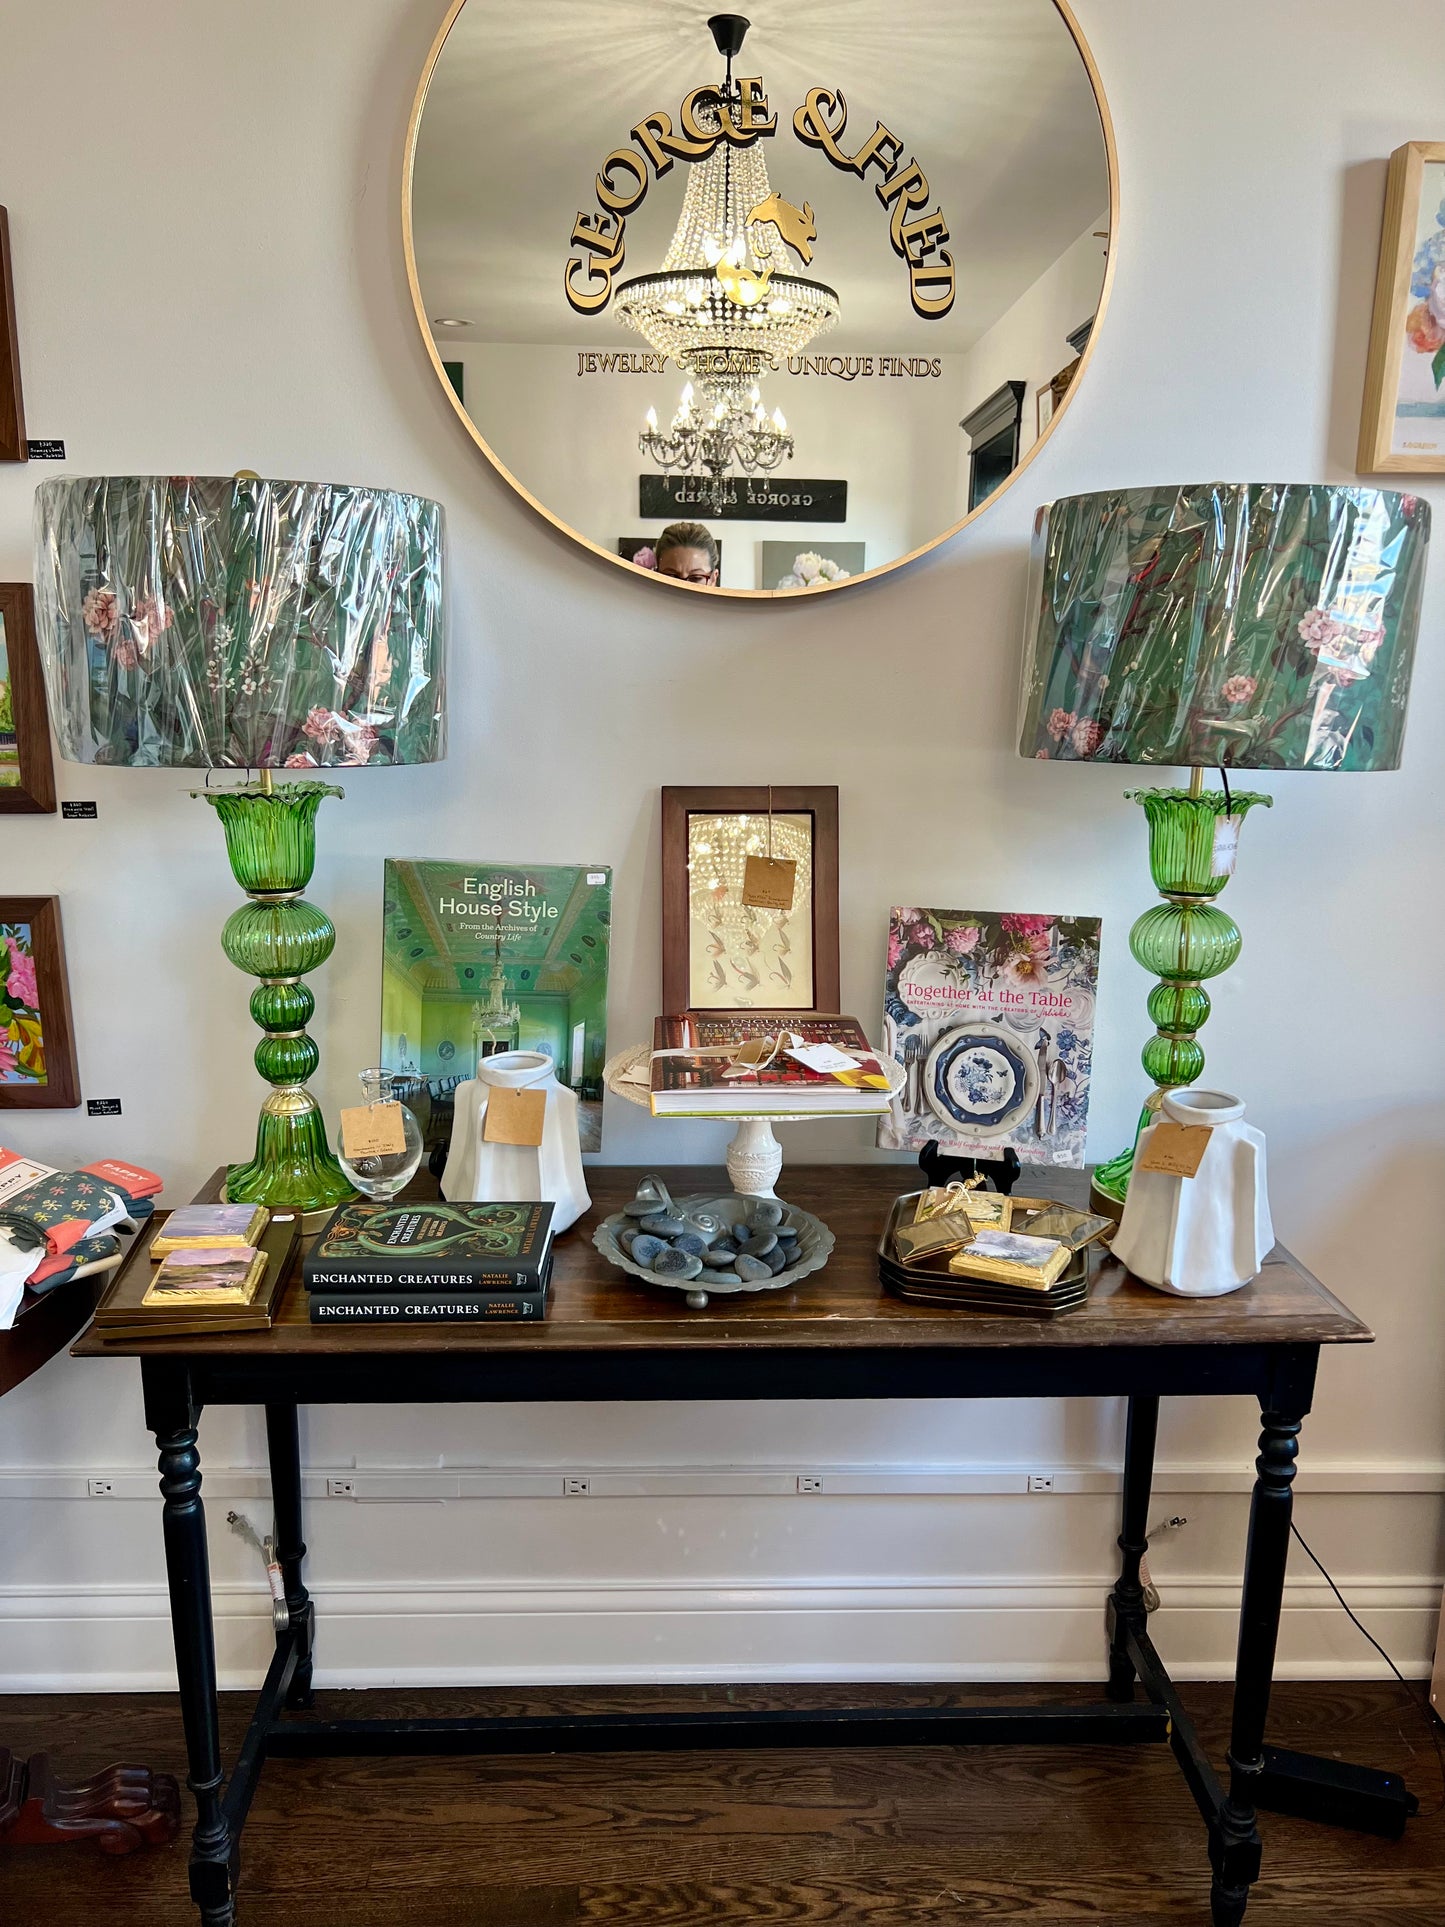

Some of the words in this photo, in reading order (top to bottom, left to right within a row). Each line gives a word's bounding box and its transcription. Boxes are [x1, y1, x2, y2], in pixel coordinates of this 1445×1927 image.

[564, 76, 777, 315] GEORGE
[792, 86, 865, 179] &
[848, 120, 957, 320] FRED
[577, 353, 669, 377] JEWELRY
[693, 354, 760, 375] HOME
[787, 355, 874, 381] UNIQUE
[878, 357, 942, 378] FINDS
[463, 877, 536, 901] English
[439, 897, 502, 917] House
[508, 900, 559, 923] Style
[460, 922, 480, 931] From
[481, 923, 494, 931] the
[495, 923, 528, 932] Archives
[529, 924, 538, 932] of
[475, 932, 505, 942] Country
[507, 932, 522, 941] Life
[905, 982, 973, 1001] Together
[977, 989, 994, 1002] at
[999, 989, 1024, 1004] the
[1029, 991, 1073, 1008] Table
[906, 999, 945, 1007] ENTERTAINING
[0, 1174, 21, 1189] PPY
[102, 1163, 150, 1181] PAPPY
[386, 1213, 410, 1244] ENCHANTED
[400, 1214, 422, 1244] CREATURES
[521, 1231, 535, 1254] NATALIE
[312, 1273, 393, 1284] ENCHANTED
[398, 1273, 473, 1284] CREATURES
[318, 1306, 400, 1316] ENCHANTED
[405, 1304, 479, 1316] CREATURES
